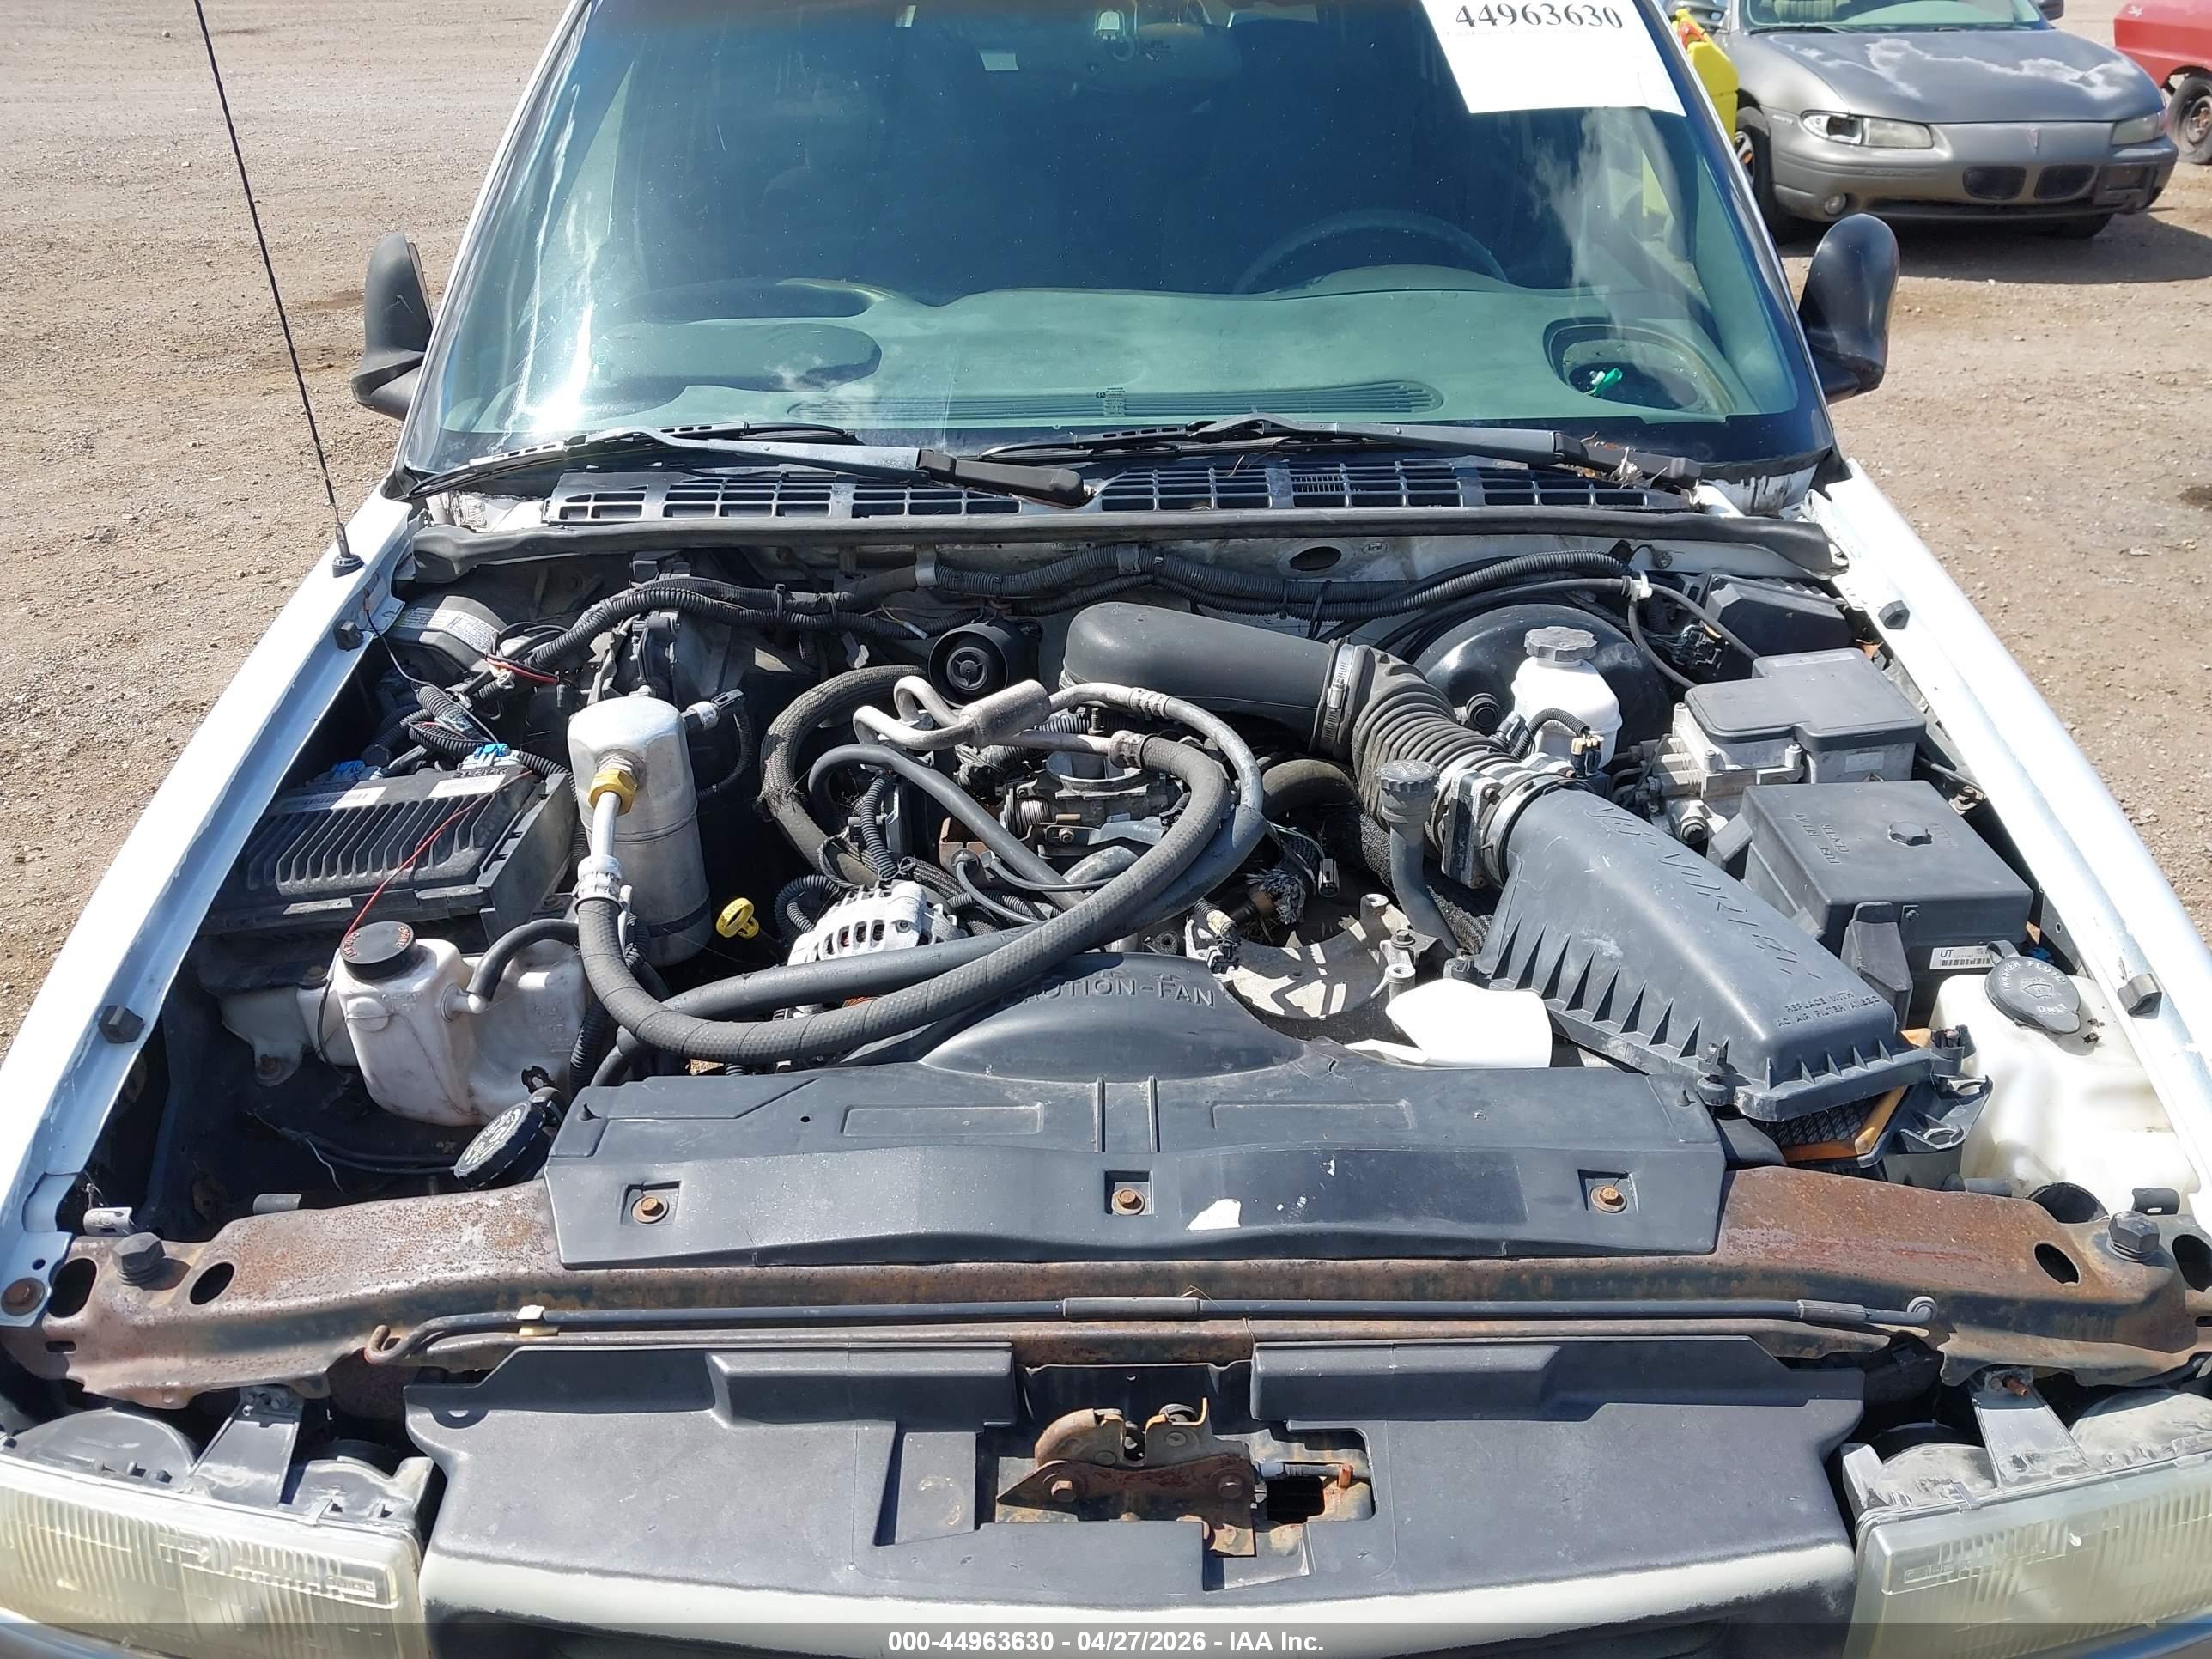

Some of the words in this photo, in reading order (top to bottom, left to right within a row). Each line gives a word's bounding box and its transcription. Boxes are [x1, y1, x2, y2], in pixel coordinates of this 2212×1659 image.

[1455, 3, 1623, 28] 44963630
[1940, 949, 1954, 958] UT
[2027, 960, 2067, 983] FLUID
[2037, 1002, 2069, 1014] ONLY
